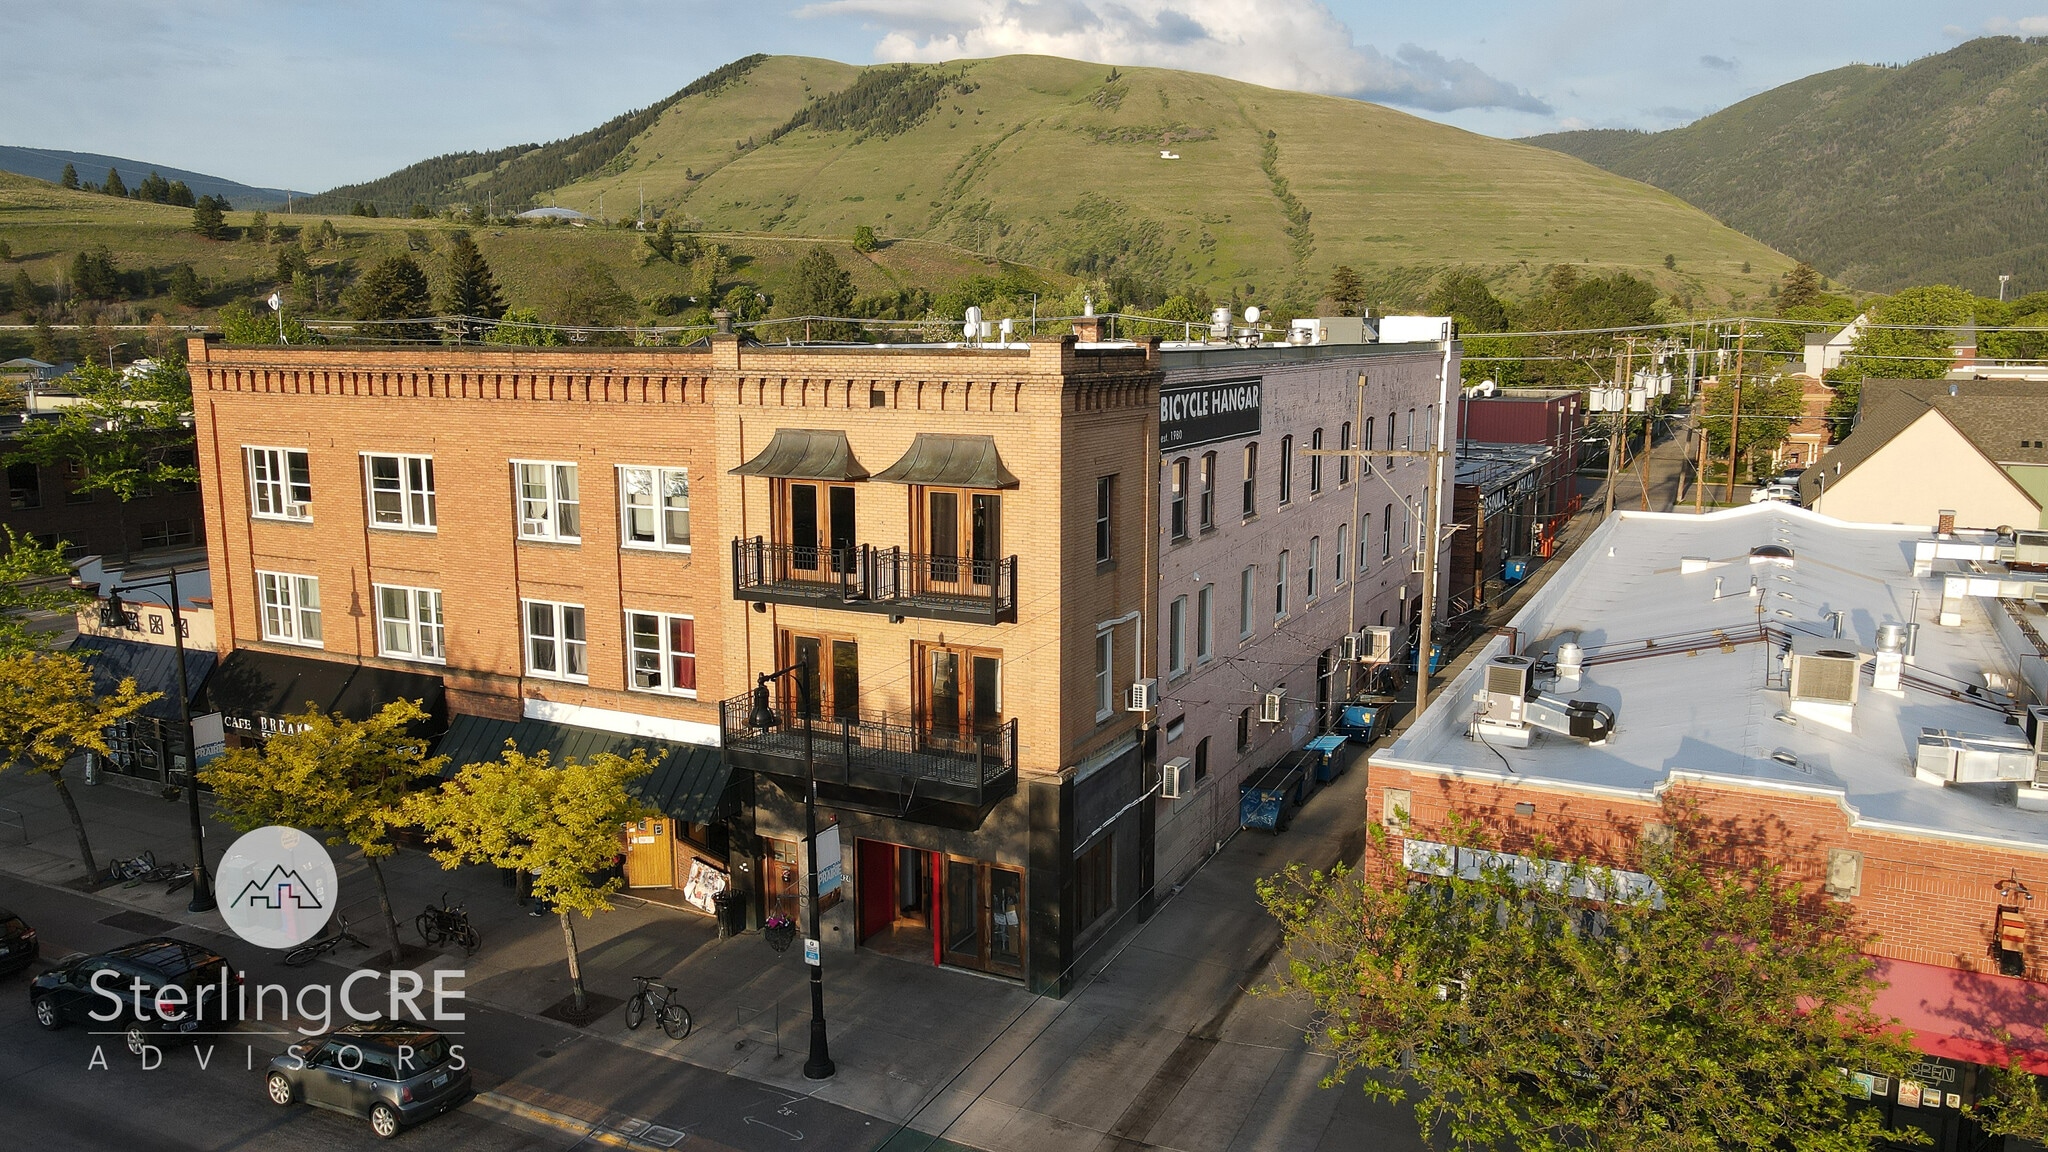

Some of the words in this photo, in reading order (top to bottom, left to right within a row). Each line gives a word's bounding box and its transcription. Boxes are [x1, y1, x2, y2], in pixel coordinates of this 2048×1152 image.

[1161, 391, 1209, 421] BICYCLE
[1211, 385, 1259, 415] HANGAR
[1170, 429, 1183, 441] 1980
[224, 716, 252, 730] CAFE
[1910, 1063, 1953, 1081] OPEN
